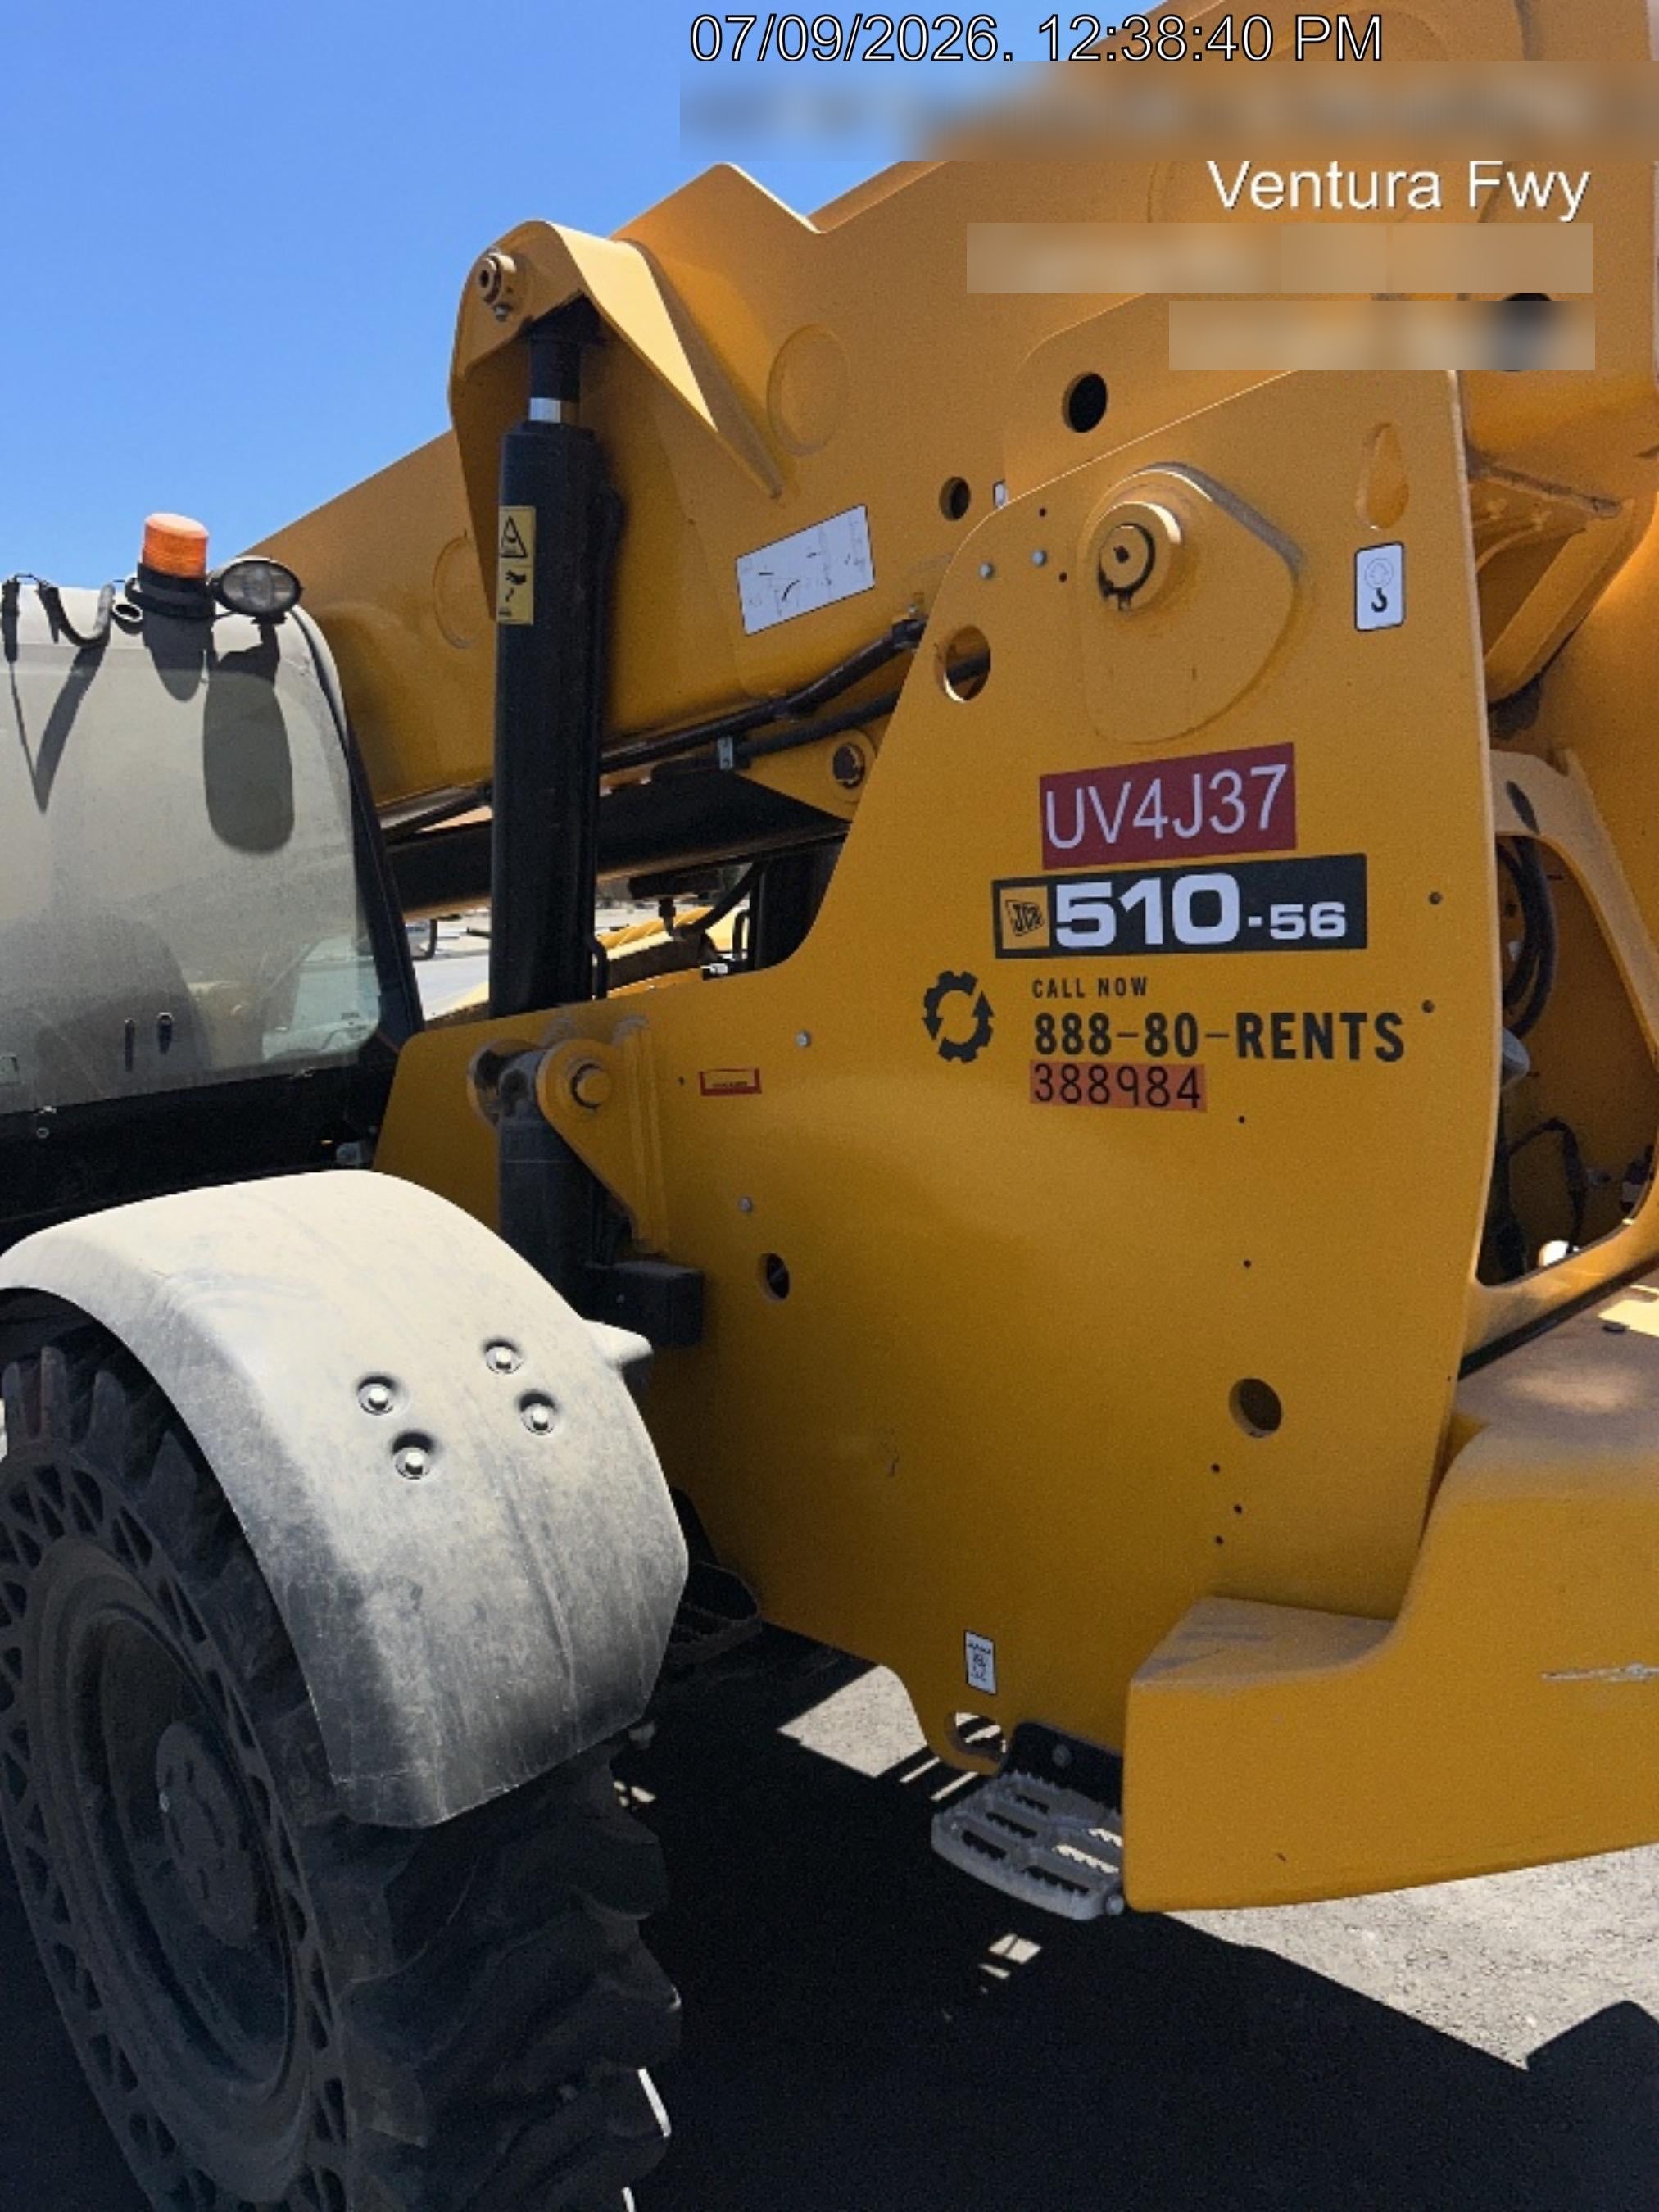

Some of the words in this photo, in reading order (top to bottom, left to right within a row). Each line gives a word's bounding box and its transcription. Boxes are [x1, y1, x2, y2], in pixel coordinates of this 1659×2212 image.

[1045, 763, 1287, 850] UV4J37
[1055, 873, 1347, 948] 510-56
[1032, 977, 1085, 998] CALL
[1098, 976, 1147, 997] NOW
[1034, 1011, 1405, 1062] 888-80-RENTS
[1034, 1063, 1200, 1109] 388984
